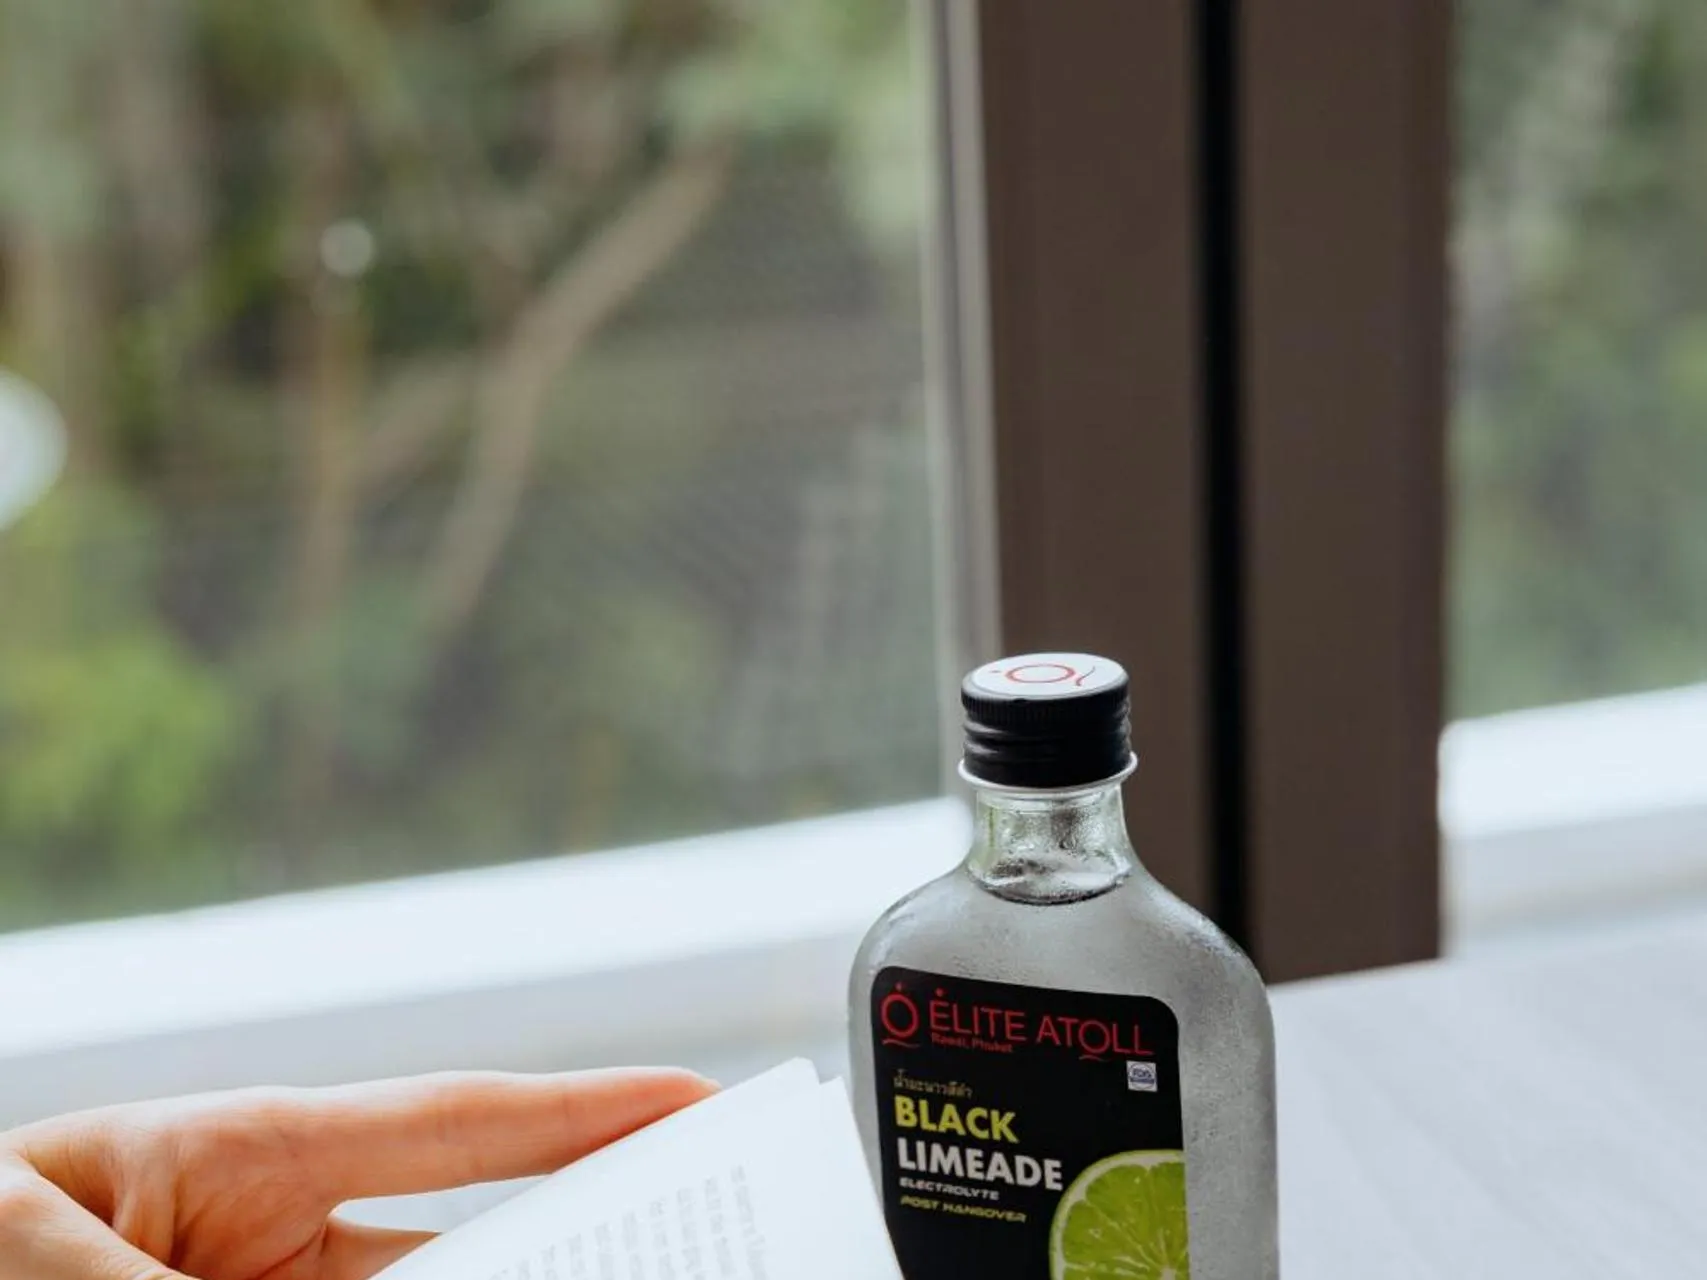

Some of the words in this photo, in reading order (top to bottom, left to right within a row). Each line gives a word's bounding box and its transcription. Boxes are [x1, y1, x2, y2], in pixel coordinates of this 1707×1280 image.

[1036, 1015, 1154, 1058] ATOLL
[895, 1096, 1019, 1143] BLACK
[898, 1139, 1063, 1191] LIMEADE
[899, 1178, 1000, 1200] ELECTROLYTE
[900, 1195, 940, 1212] POST
[943, 1200, 1028, 1223] HANGOVER
